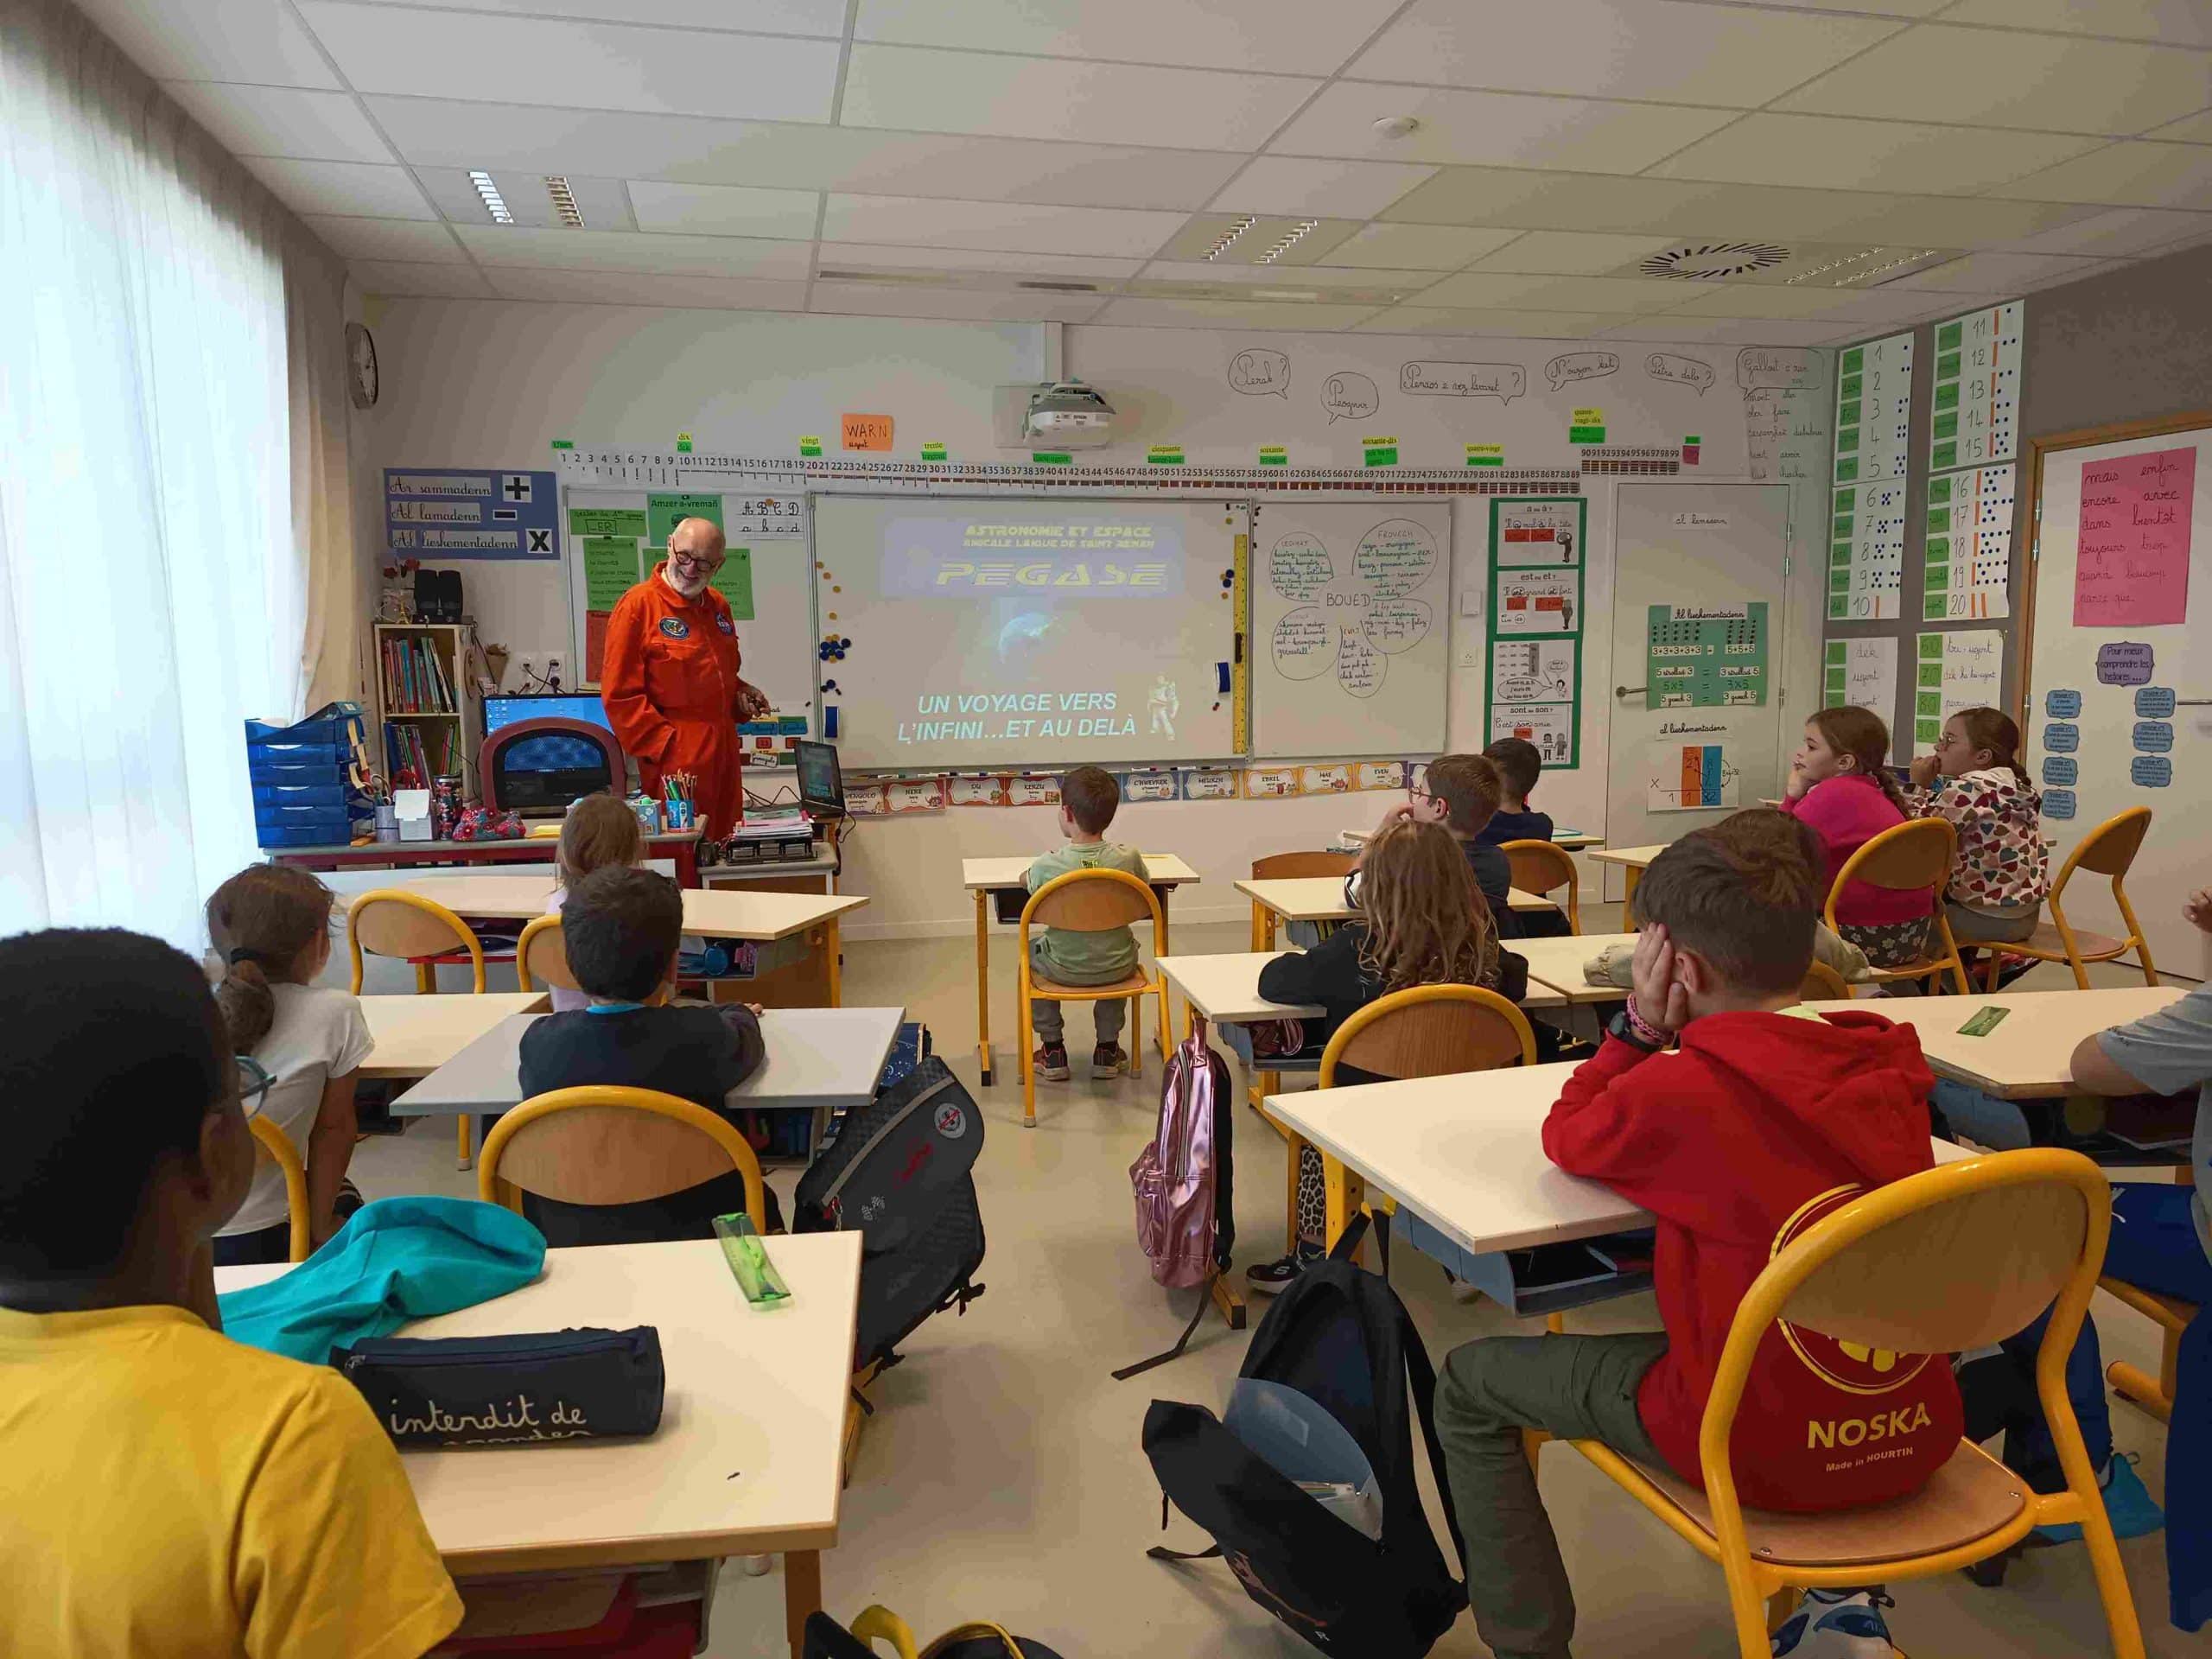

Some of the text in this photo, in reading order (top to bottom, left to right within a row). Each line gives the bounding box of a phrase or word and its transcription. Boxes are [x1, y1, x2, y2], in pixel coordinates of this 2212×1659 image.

[1973, 323, 1986, 339] 11
[1874, 345, 1884, 360] 1
[1971, 349, 1985, 366] 12
[1872, 372, 1881, 391] 2
[1970, 380, 1985, 401] 13
[1870, 399, 1880, 420] 3
[1967, 408, 1984, 428] 14
[801, 435, 819, 446] vingt
[846, 423, 887, 438] WARN
[1870, 426, 1880, 443] 4
[1966, 436, 1982, 458] 15
[562, 454, 715, 467] 1 2 3 4 5 6 7 8 9 10 11 12
[1869, 455, 1880, 479] 5
[391, 477, 490, 496] Ar sammadenn
[1954, 476, 1970, 499] 16
[2084, 471, 2119, 486] mais
[651, 499, 677, 508] Amzer
[1866, 486, 1877, 508] 6
[2082, 492, 2181, 508] encore avec
[391, 503, 480, 522] Al lamadenn
[741, 501, 753, 516] A
[757, 501, 768, 516] B
[788, 501, 799, 516] D
[1954, 507, 1968, 529] 17
[761, 518, 769, 532] b
[791, 521, 800, 532] d
[964, 525, 1153, 537] ASTRONOMIE ET ESPACE
[1866, 516, 1874, 534] 7
[2082, 518, 2113, 531] dans
[1862, 542, 1870, 563] 8
[1955, 537, 1965, 558] 18
[2079, 537, 2127, 565] toujours
[935, 562, 1169, 588] PEGASE
[1859, 569, 1867, 590] 9
[1954, 567, 1965, 588] 19
[1326, 593, 1370, 607] BOUED
[1853, 596, 1871, 617] 10
[1949, 593, 1966, 616] 20
[918, 692, 1117, 715] UN VOYAGE VERS
[1039, 721, 1074, 739] AU
[1078, 714, 1138, 738] DELÀ
[391, 1395, 588, 1435] interdit de
[1807, 1402, 1932, 1449] NOSKA
[1826, 1446, 1914, 1472] Made in HOURTIN
